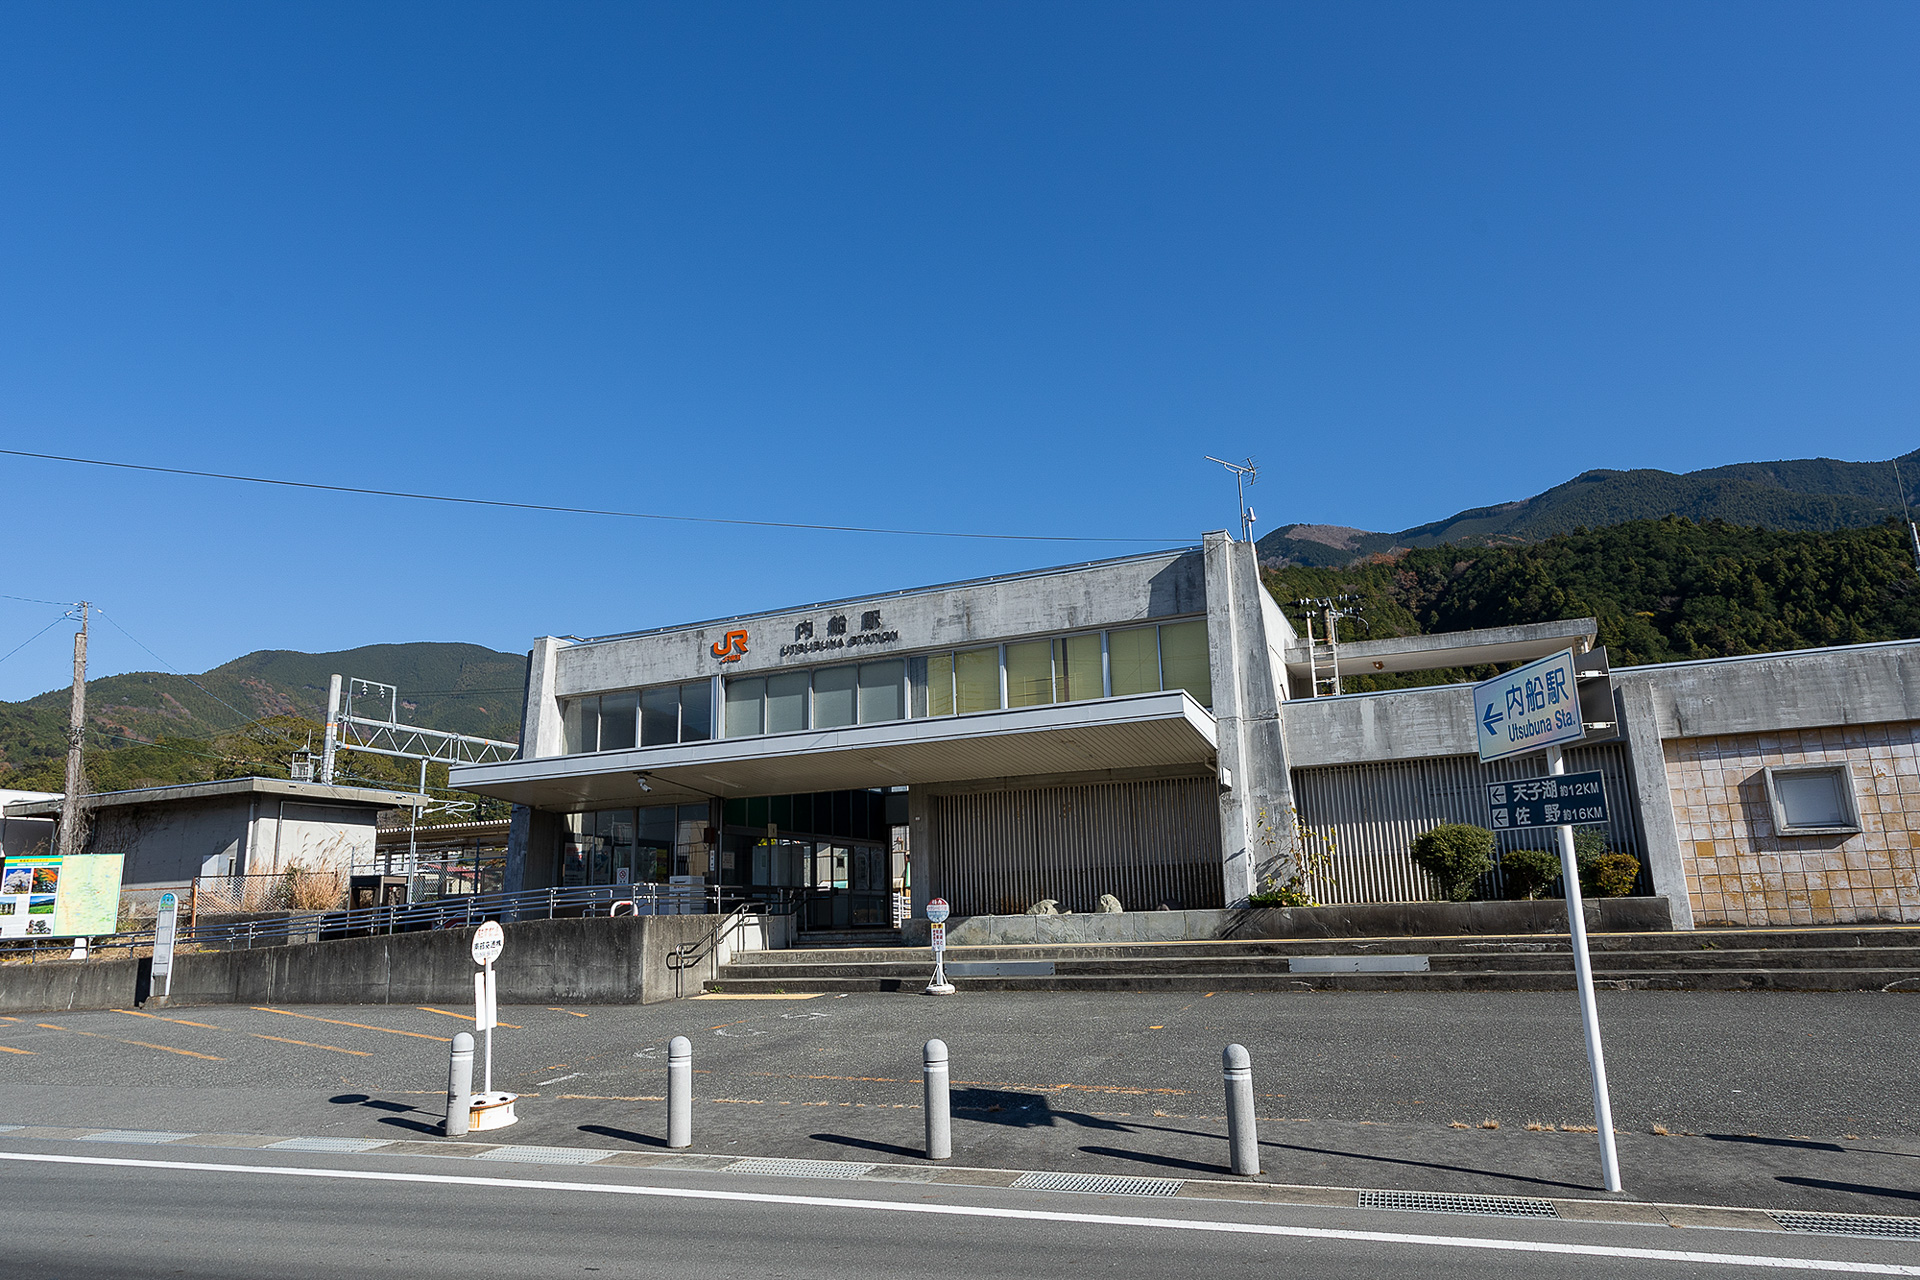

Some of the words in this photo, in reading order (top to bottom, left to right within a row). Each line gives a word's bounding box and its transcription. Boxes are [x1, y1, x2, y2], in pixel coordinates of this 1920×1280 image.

[795, 610, 881, 641] 内船駅
[713, 629, 748, 656] JR
[780, 638, 845, 657] UTSUBUNA
[847, 630, 899, 648] STATION
[1505, 667, 1569, 720] 内船駅
[1508, 715, 1553, 743] Utsubuna
[1554, 708, 1576, 730] Sta.
[1513, 780, 1558, 802] 天子湖
